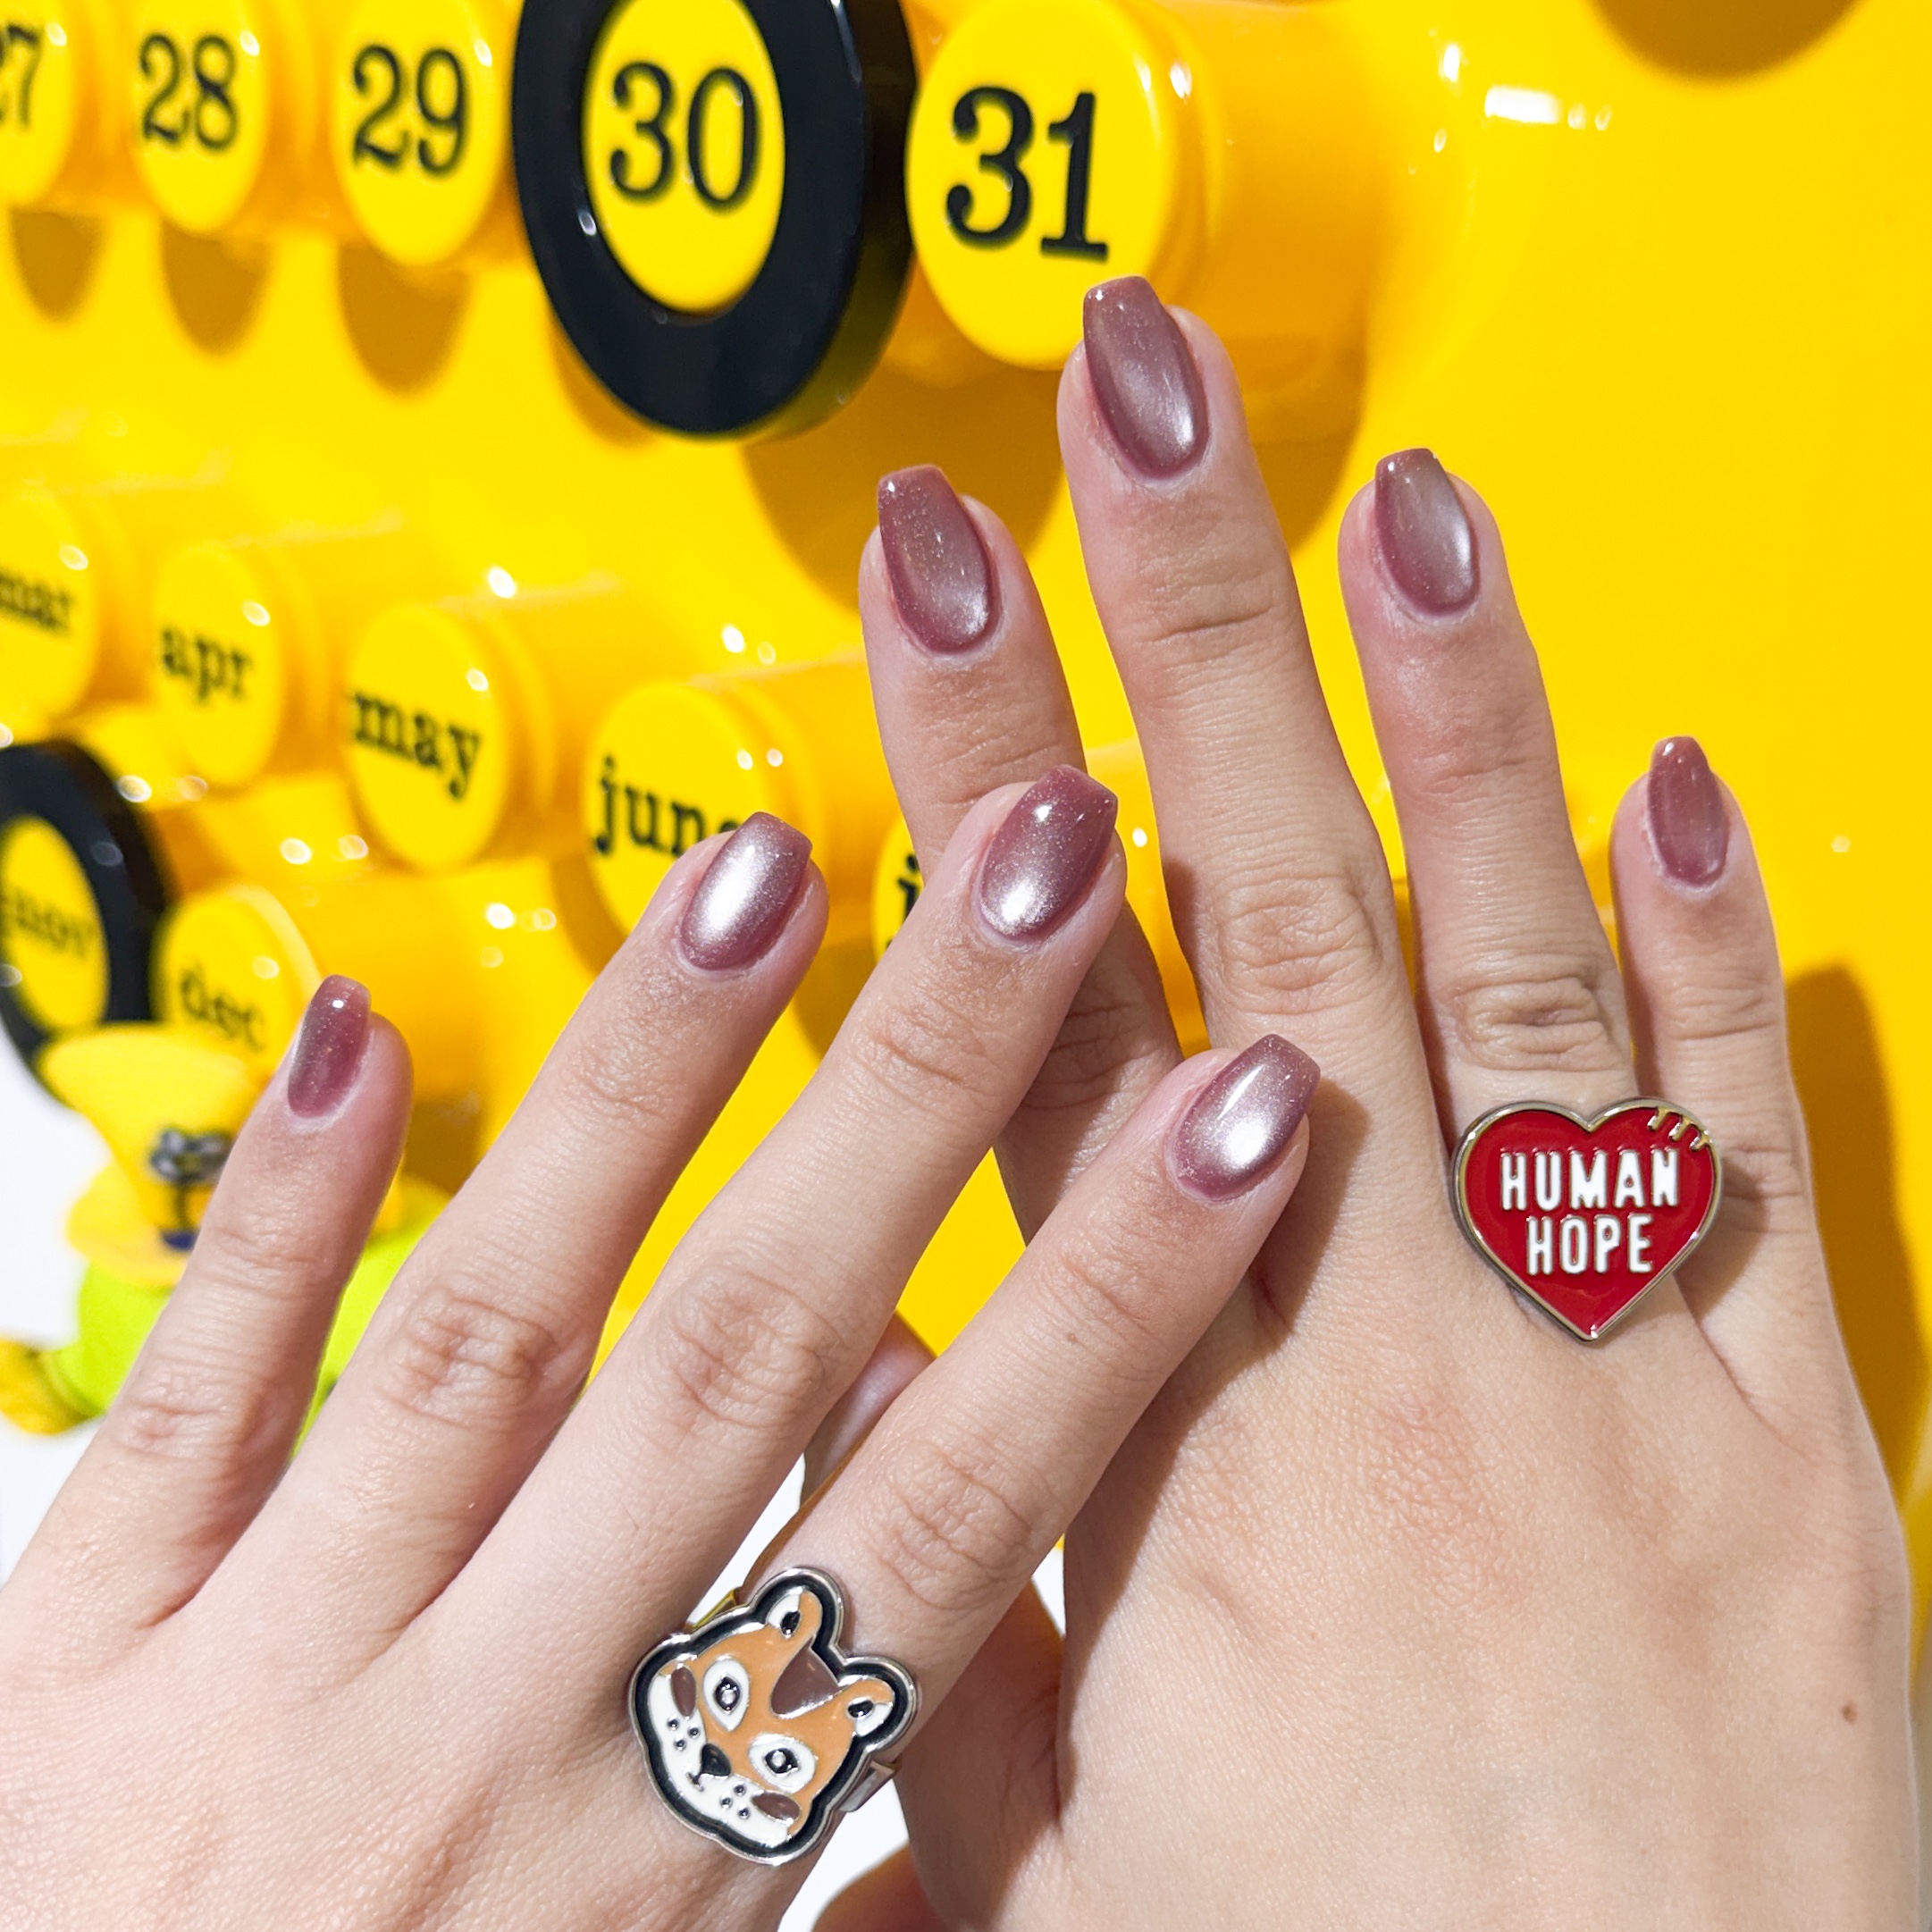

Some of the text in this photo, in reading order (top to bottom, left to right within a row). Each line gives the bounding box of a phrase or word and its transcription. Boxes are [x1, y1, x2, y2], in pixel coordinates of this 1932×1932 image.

[0, 23, 41, 130] 7
[139, 33, 239, 151] 28
[352, 45, 467, 174] 29
[608, 62, 760, 213] 30
[945, 86, 1109, 264] 31
[161, 627, 251, 704] apr
[351, 691, 481, 802] may
[1500, 1148, 1677, 1211] HUMAN
[1526, 1214, 1652, 1275] HOPE
